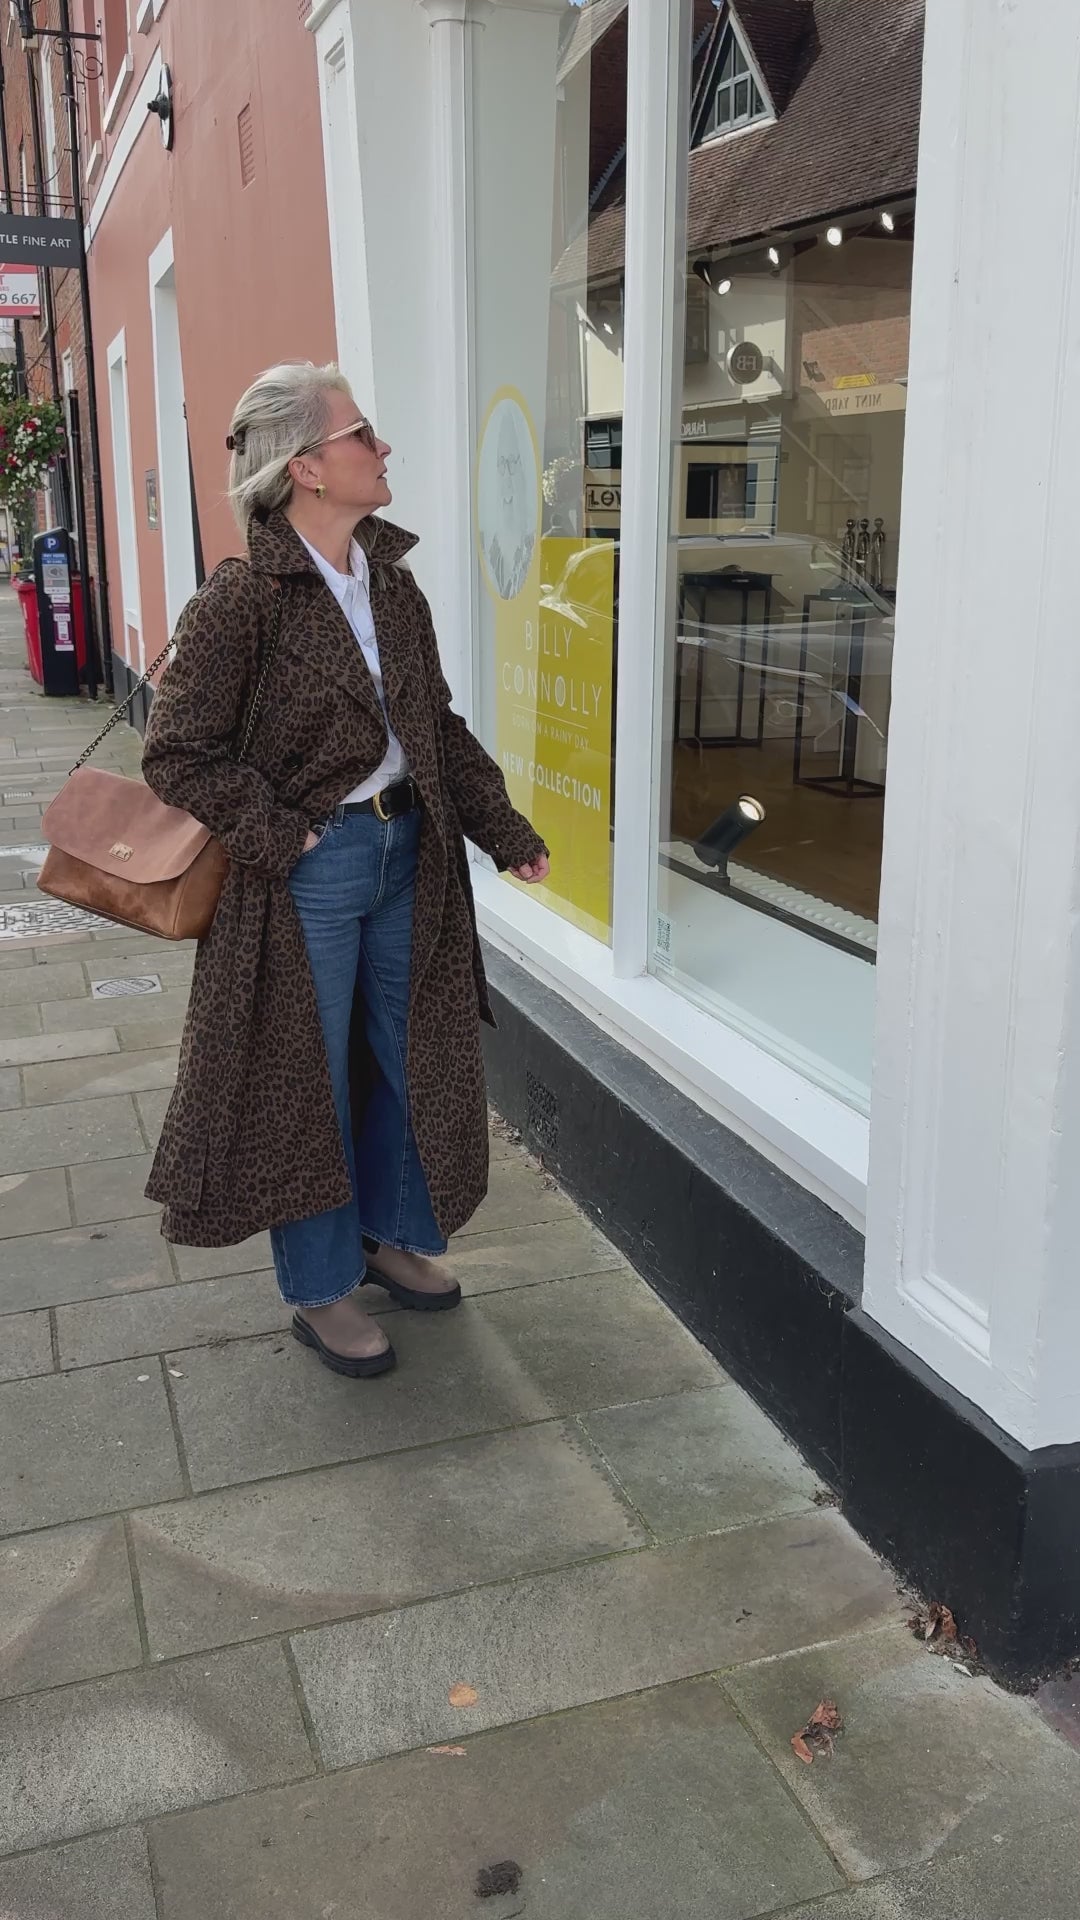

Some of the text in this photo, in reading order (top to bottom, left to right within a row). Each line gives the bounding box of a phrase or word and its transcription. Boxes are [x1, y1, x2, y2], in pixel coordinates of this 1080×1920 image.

[23, 236, 46, 247] FINE
[50, 238, 71, 248] ART
[12, 293, 37, 304] 667
[525, 620, 572, 659] BILLY
[502, 662, 602, 718] CONNOLLY
[550, 725, 573, 745] RAINY
[574, 734, 590, 750] DAY
[503, 751, 601, 811] NEW COLLECTION
